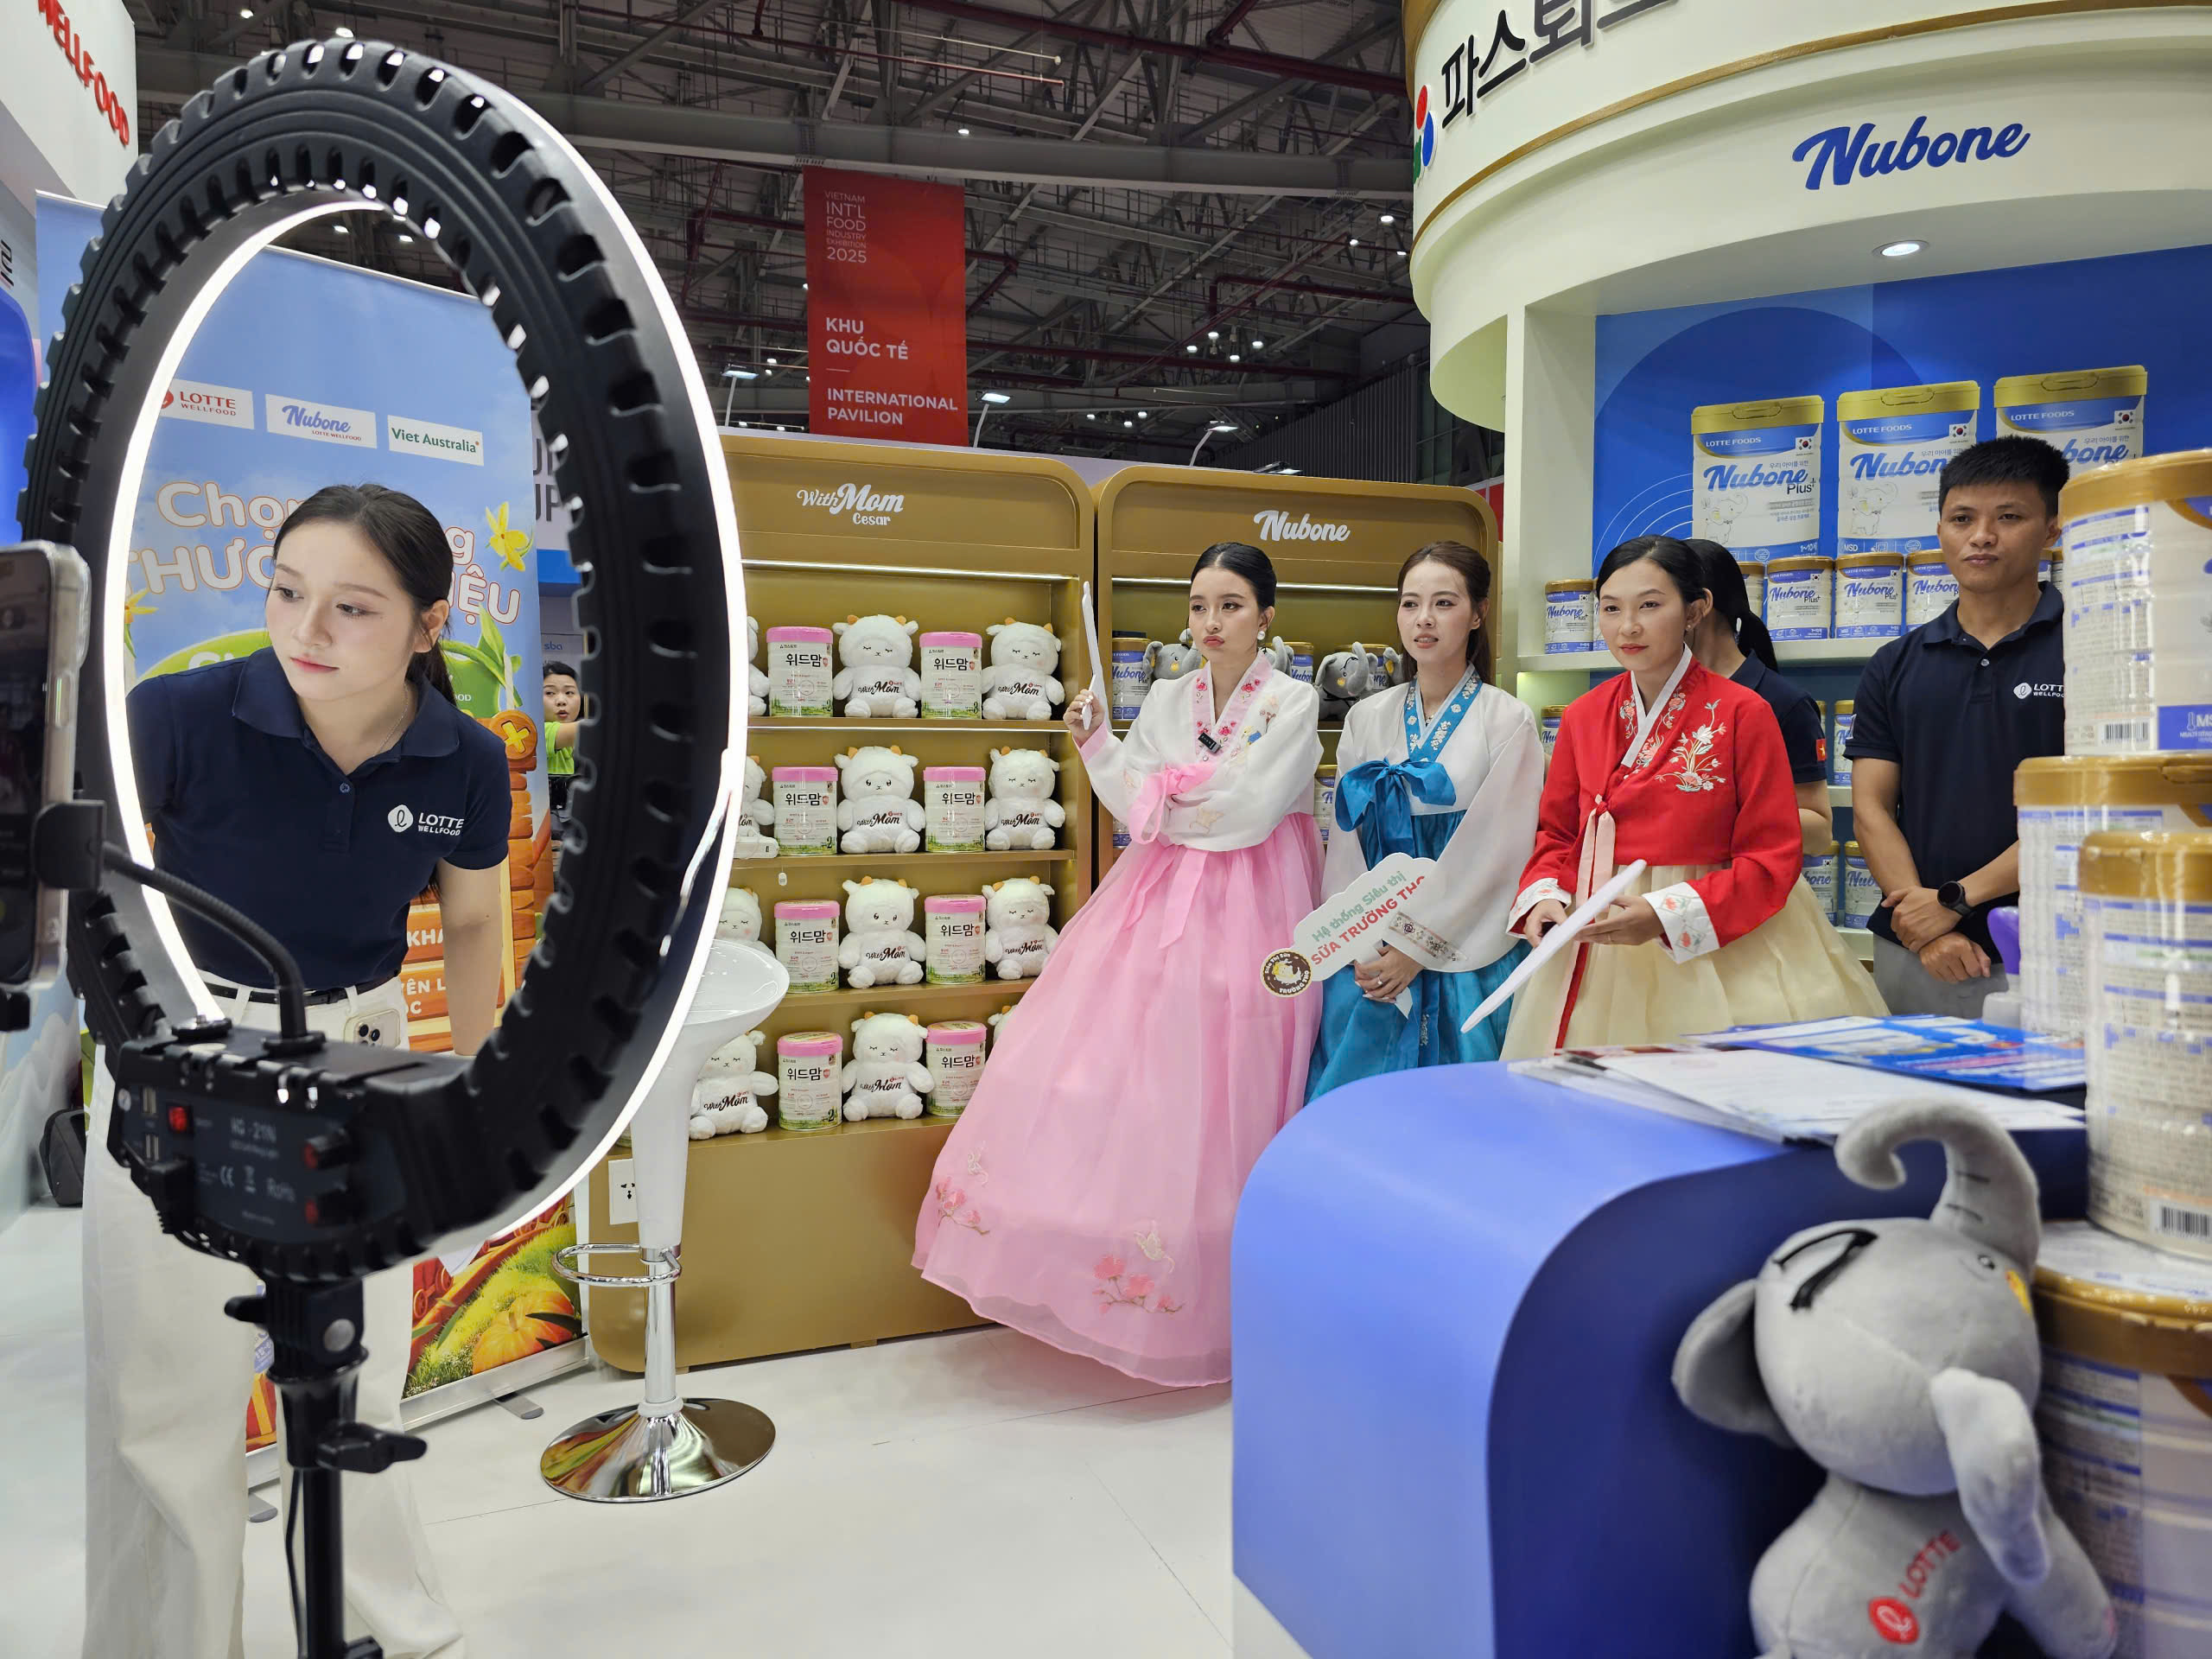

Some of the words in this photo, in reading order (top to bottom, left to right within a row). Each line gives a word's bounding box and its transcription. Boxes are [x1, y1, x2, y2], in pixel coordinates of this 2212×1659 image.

[1441, 0, 1680, 129] 파스퇴
[1791, 115, 2031, 191] Nubone
[824, 191, 865, 203] VIETNAM
[826, 216, 866, 232] FOOD
[826, 229, 867, 240] INDUSTRY
[827, 246, 867, 264] 2025
[826, 317, 864, 334] KHU
[826, 336, 880, 357] QUỐC
[887, 340, 908, 359] TẾ
[180, 391, 236, 410] LOTTE
[828, 388, 958, 410] INTERNATIONAL
[181, 403, 237, 416] WELLFOOD
[828, 407, 903, 425] PAVILION
[2041, 410, 2075, 419] FOODS
[283, 404, 351, 433] Nubone
[312, 429, 330, 438] LOTTE
[391, 428, 419, 444] Viet
[423, 433, 476, 453] Australia
[2062, 439, 2129, 464] bone
[1849, 452, 1948, 480] Nubon
[1703, 463, 1808, 492] Nubone
[853, 512, 891, 525] Cesar
[1254, 510, 1351, 541] Nubone
[1770, 587, 1815, 601] Nubone
[1845, 582, 1894, 597] Nubone
[1546, 605, 1583, 619] Nubone
[785, 653, 822, 667] 위드맘
[934, 658, 968, 671] 위드맘
[785, 792, 822, 805] 위드맘
[942, 792, 976, 804] 위드맘
[418, 812, 465, 829] LOTTE
[417, 825, 461, 836] WELLFOOD
[1312, 925, 1331, 942] Hệ
[1329, 904, 1364, 929] thống
[1362, 884, 1388, 906] Siêu
[1387, 870, 1407, 887] thị
[790, 930, 826, 944] 위드맘
[940, 923, 974, 937] 위드맘
[1311, 941, 1342, 965] SỮA
[1339, 899, 1398, 943] TRƯỜNG
[941, 1054, 976, 1068] 위드맘
[787, 1067, 822, 1081] 위드맘
[1898, 1529, 1963, 1599] LOTTE
